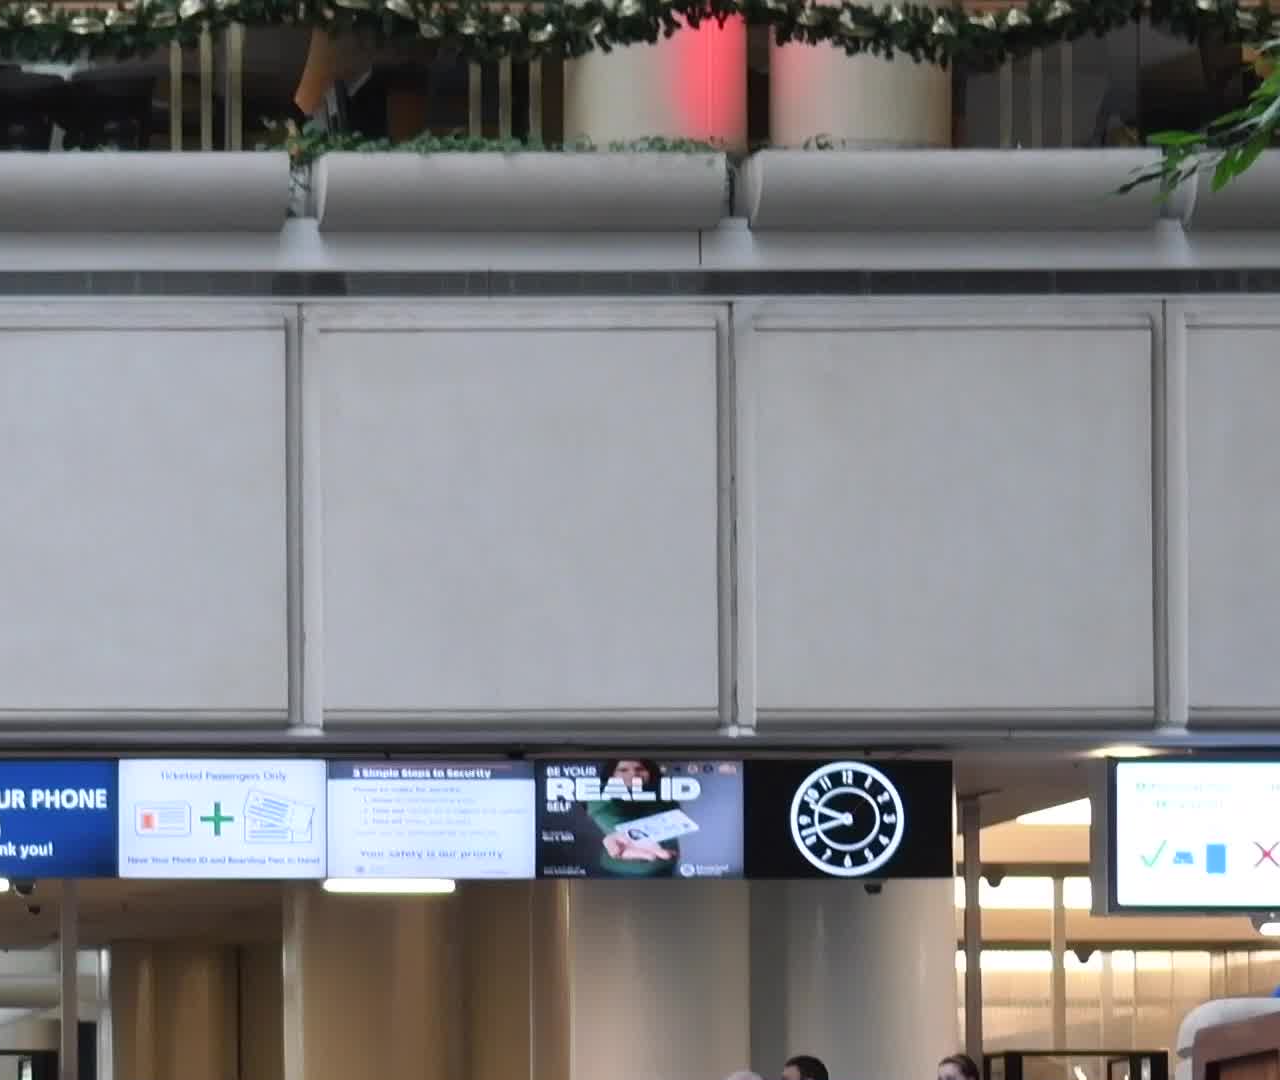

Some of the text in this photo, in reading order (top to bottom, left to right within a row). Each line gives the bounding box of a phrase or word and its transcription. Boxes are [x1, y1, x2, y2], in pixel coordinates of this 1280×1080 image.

[446, 768, 491, 780] Security
[547, 766, 597, 776] BE YOUR
[546, 776, 701, 801] REAL ID
[32, 788, 108, 809] PHONE
[20, 841, 53, 860] you!
